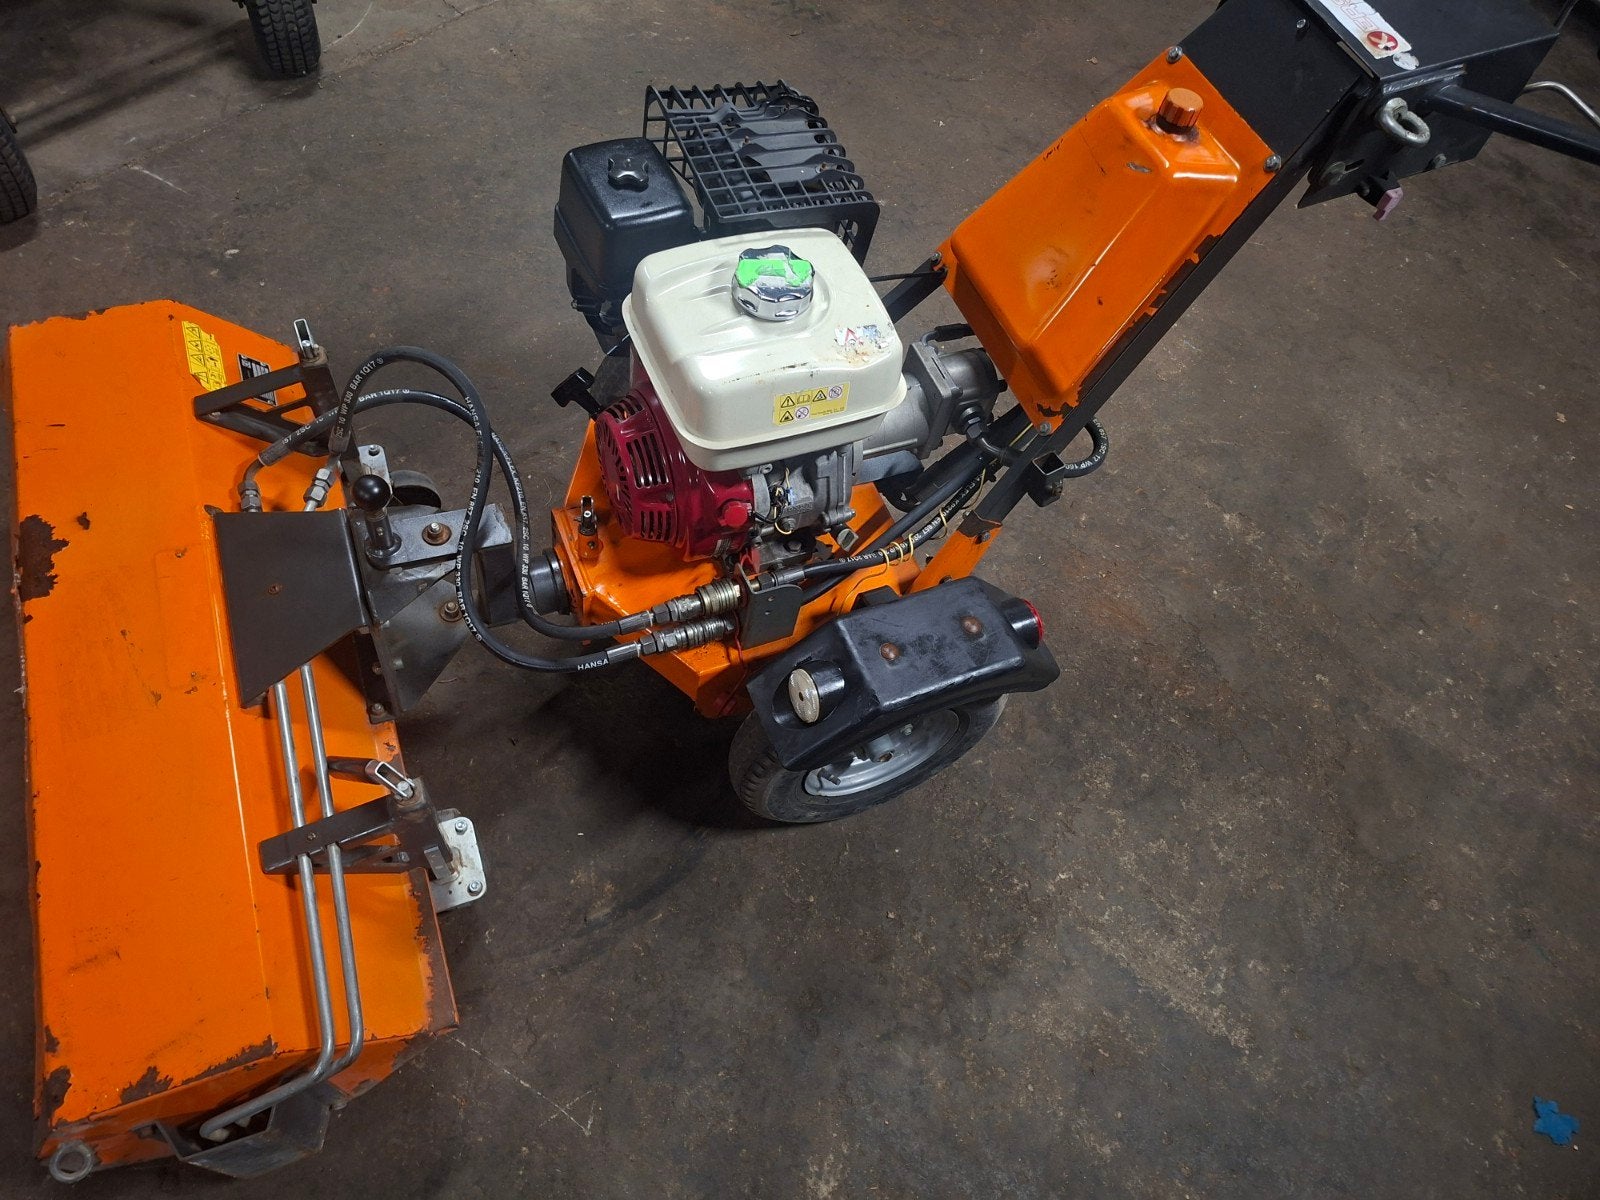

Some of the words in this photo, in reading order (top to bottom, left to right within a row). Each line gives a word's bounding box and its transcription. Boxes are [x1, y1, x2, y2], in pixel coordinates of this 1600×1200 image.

[340, 403, 348, 415] WP
[350, 374, 362, 390] BAR
[295, 424, 311, 437] 2SC
[358, 392, 377, 402] BAR
[1080, 460, 1093, 470] WP
[522, 526, 530, 540] 2SC
[522, 543, 530, 551] 10
[522, 553, 529, 564] WP
[457, 591, 466, 611] BAR
[577, 658, 609, 671] HANSA
